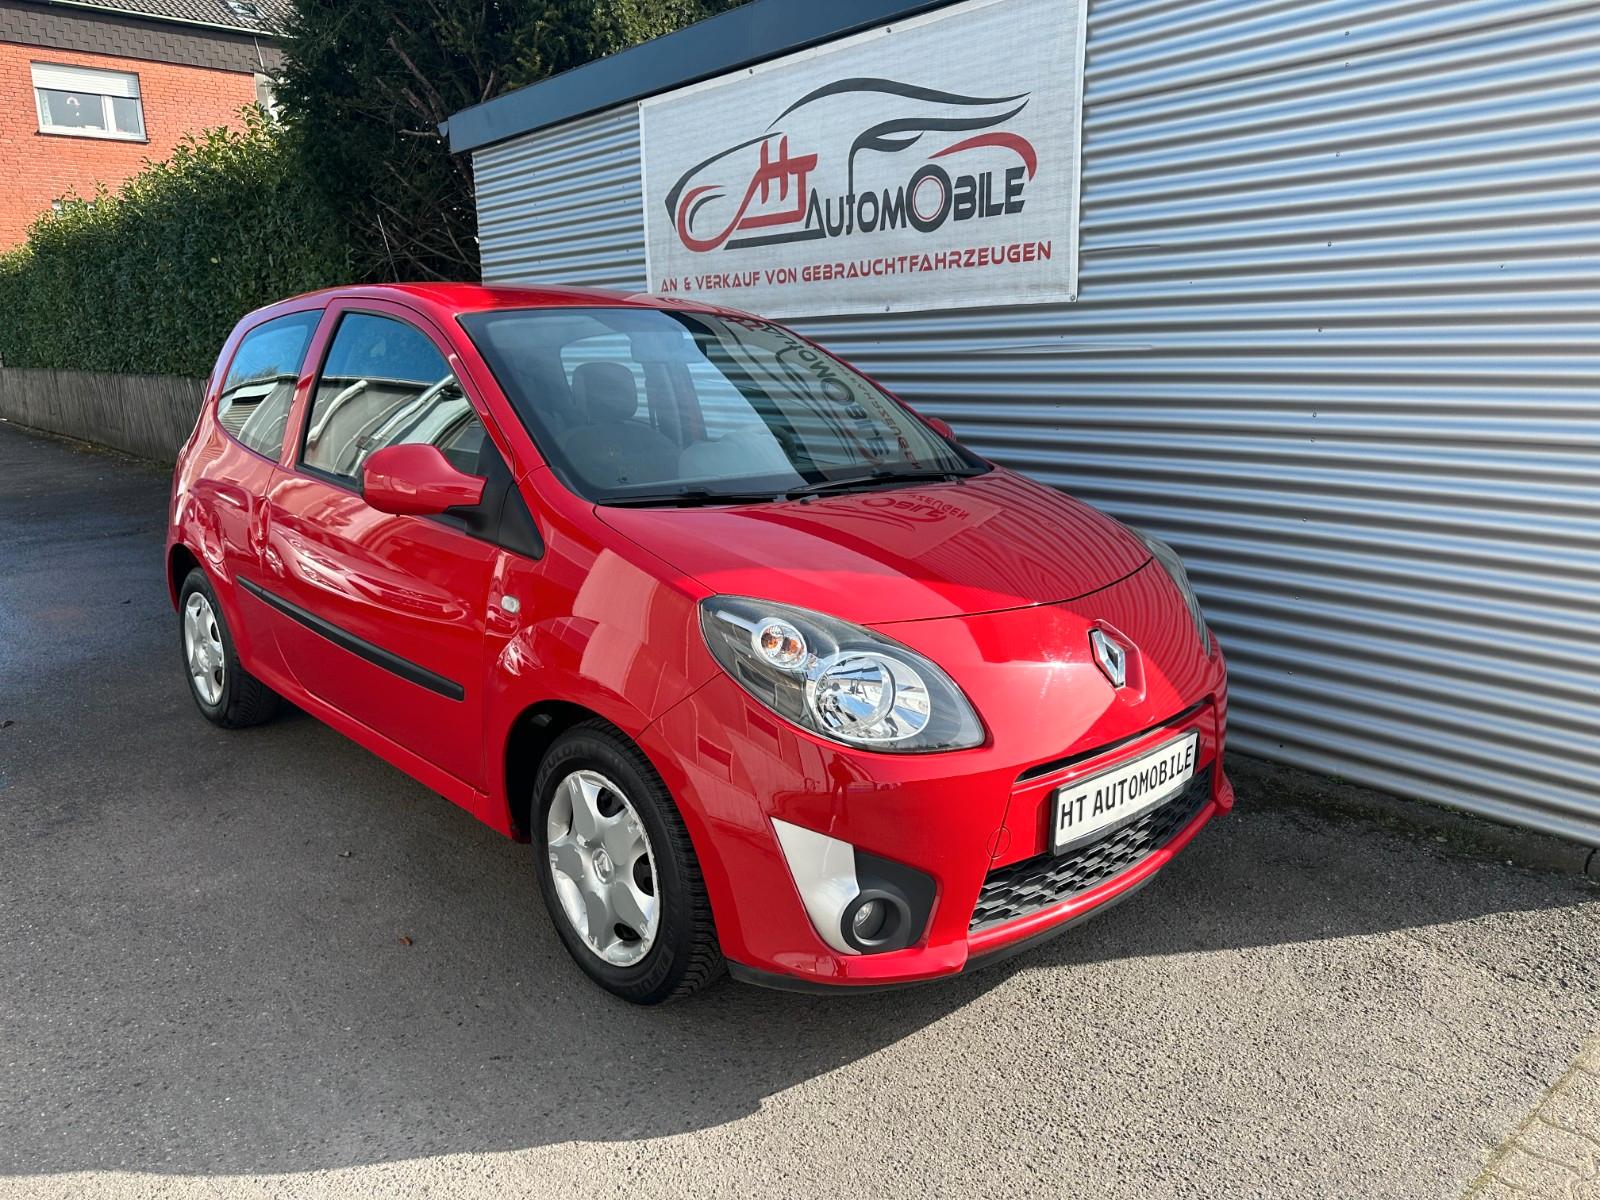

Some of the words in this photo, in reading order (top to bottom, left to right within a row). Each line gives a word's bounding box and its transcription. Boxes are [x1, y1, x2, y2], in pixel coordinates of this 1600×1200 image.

[805, 163, 1026, 239] AUTOMOBILE
[660, 279, 678, 292] AN
[684, 278, 692, 291] &
[695, 270, 761, 290] VERKAUF
[764, 267, 797, 285] VON
[801, 240, 1053, 281] GEBRAUCHTFAHRZEUGEN
[1060, 795, 1088, 830] HT
[1092, 744, 1194, 818] AUTOMOBILE
